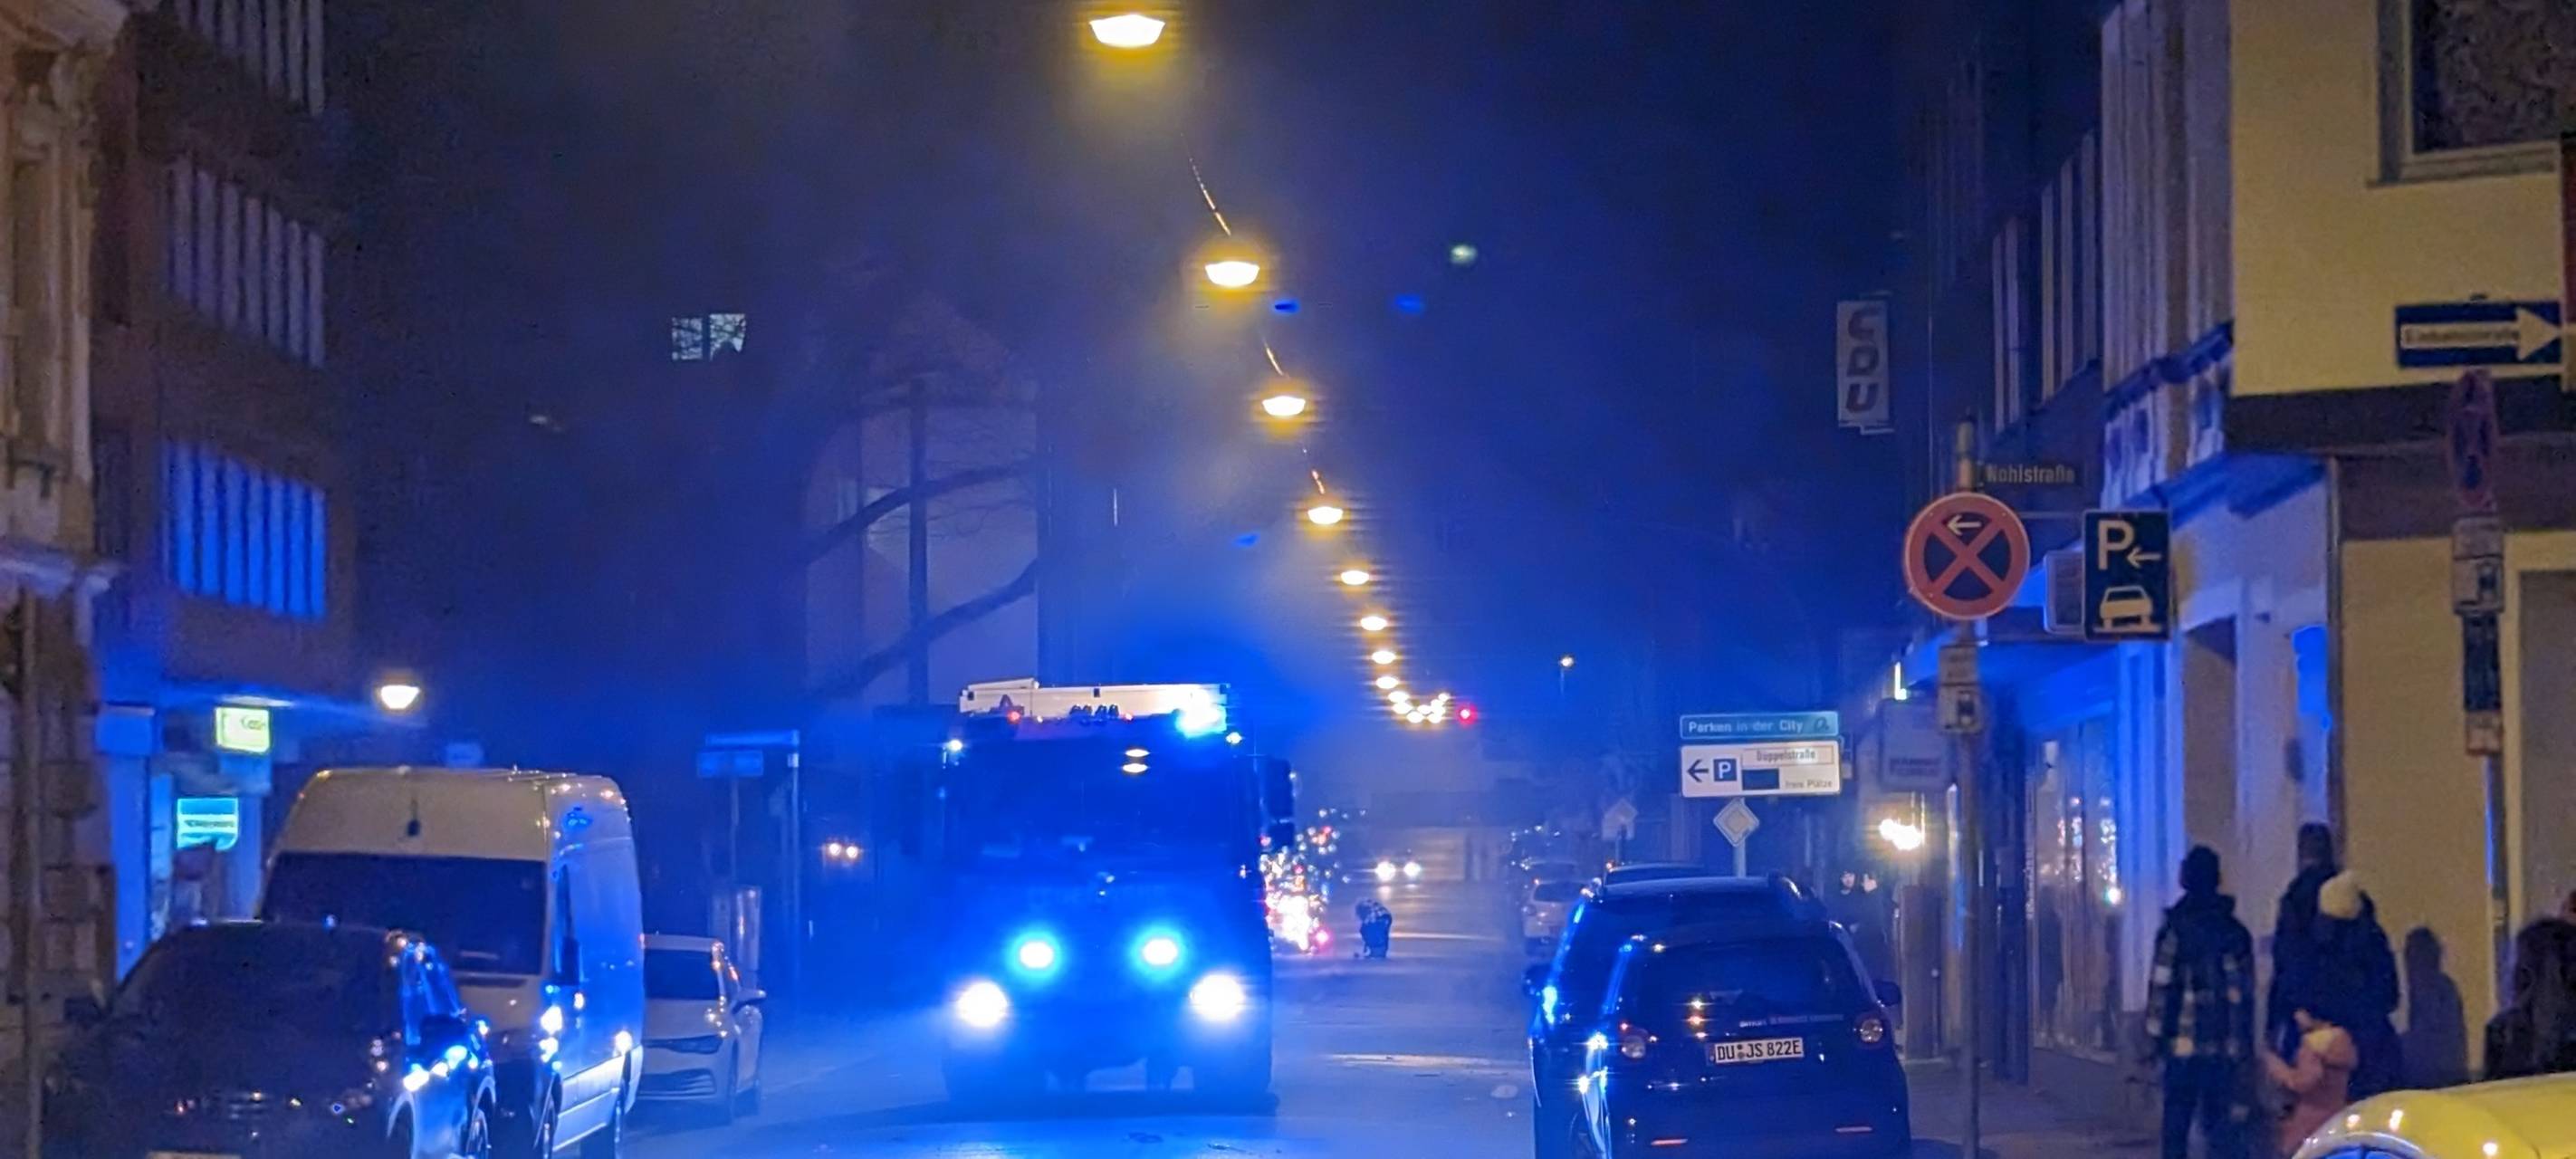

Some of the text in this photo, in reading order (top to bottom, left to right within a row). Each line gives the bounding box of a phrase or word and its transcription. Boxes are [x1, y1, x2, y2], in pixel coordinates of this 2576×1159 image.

[1845, 306, 1880, 414] CDU
[2098, 520, 2134, 570] P
[1688, 719, 1804, 733] Parken in der City
[1746, 1043, 1763, 1058] JS
[1767, 1039, 1802, 1057] 822E
